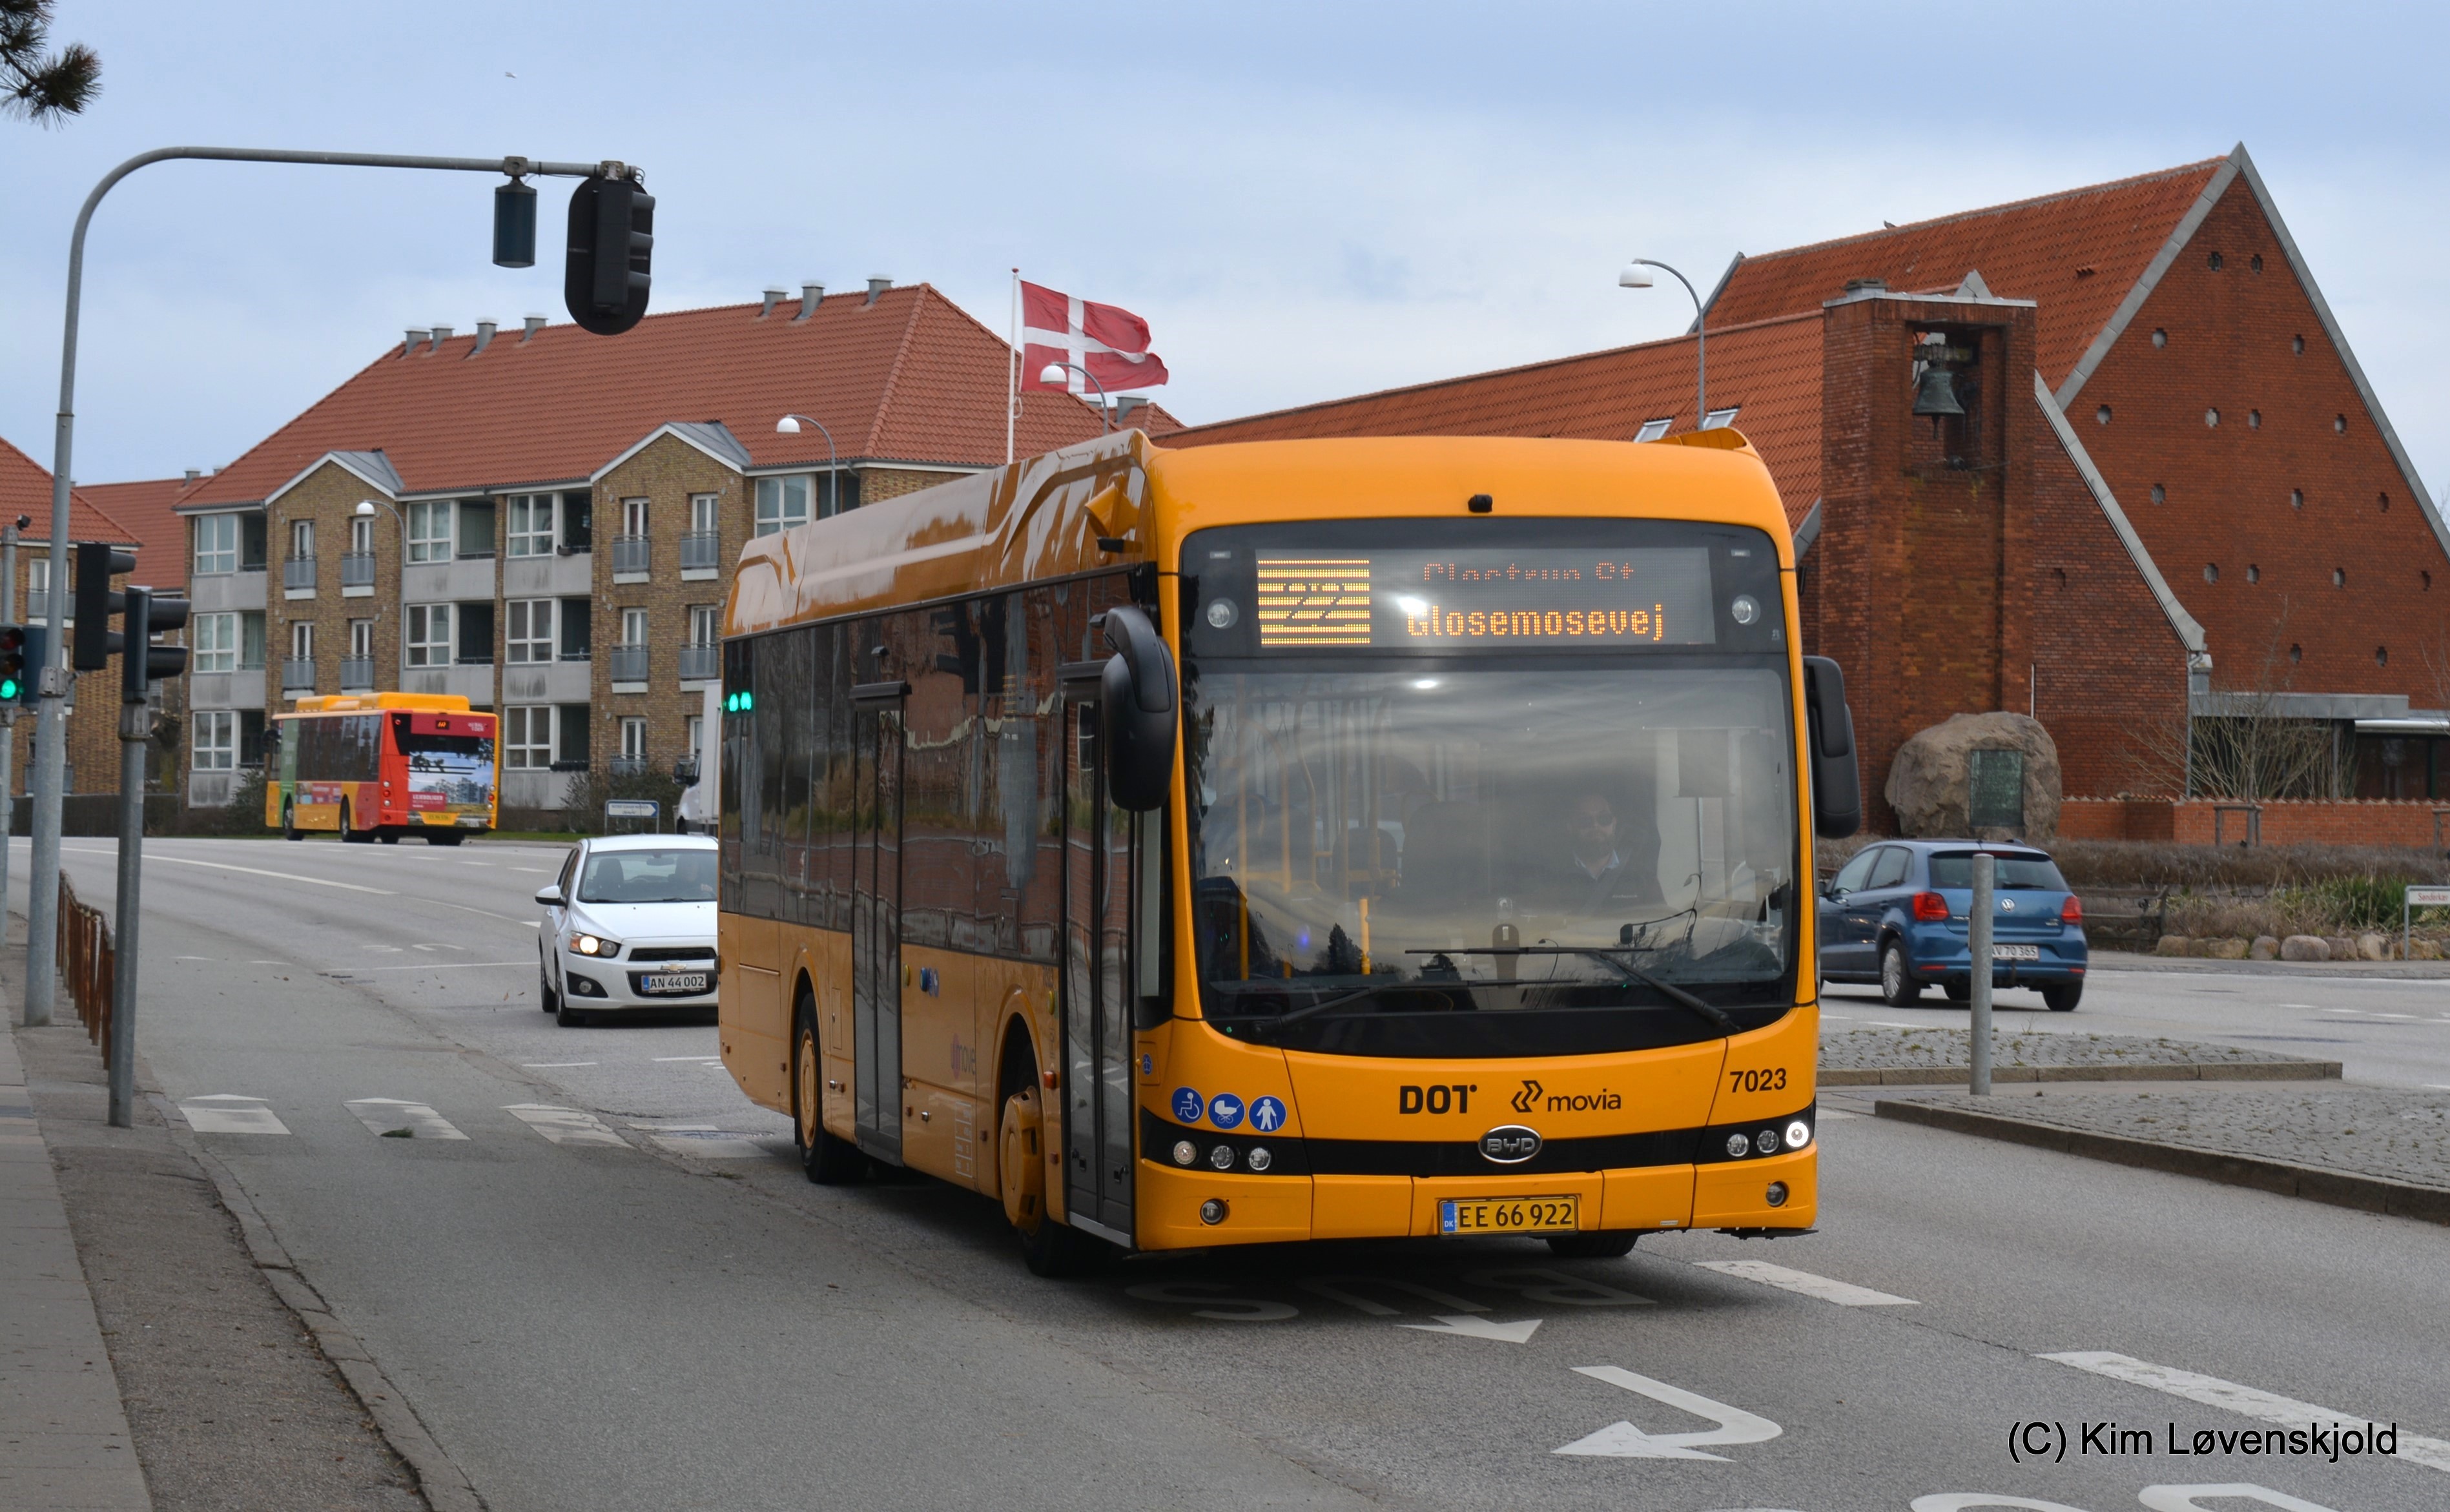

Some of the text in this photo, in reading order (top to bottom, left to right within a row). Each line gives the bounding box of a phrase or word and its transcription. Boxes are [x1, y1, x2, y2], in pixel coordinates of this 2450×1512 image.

[1407, 604, 1663, 642] Glosemosevej
[2004, 946, 2016, 956] 70
[2019, 946, 2036, 956] 365
[650, 976, 704, 988] AN 44 002
[1729, 1068, 1787, 1093] 7023
[1399, 1084, 1477, 1114] DOT
[1547, 1088, 1622, 1112] movia
[1486, 1137, 1536, 1152] BYD
[1444, 1220, 1454, 1228] DK
[1459, 1202, 1573, 1229] EE 66 922
